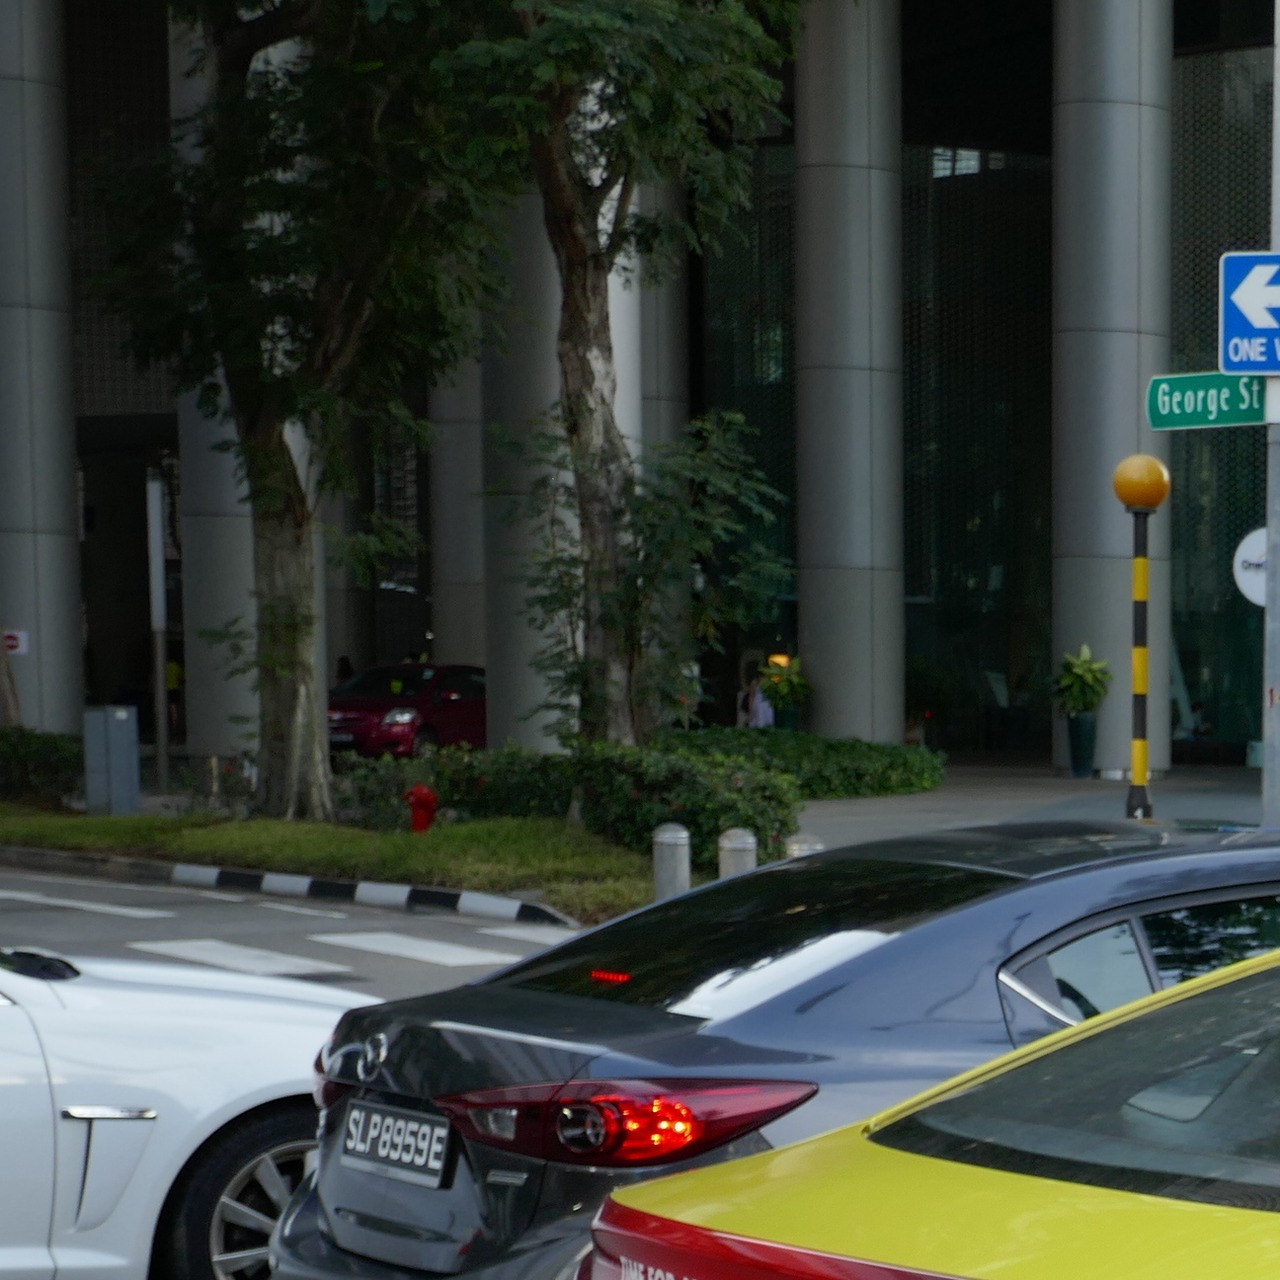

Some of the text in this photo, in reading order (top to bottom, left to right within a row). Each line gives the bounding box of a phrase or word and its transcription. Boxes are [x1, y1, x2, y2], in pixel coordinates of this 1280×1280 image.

[1228, 336, 1266, 363] ONE
[1157, 376, 1261, 421] George St
[345, 1108, 449, 1171] SLP8959E
